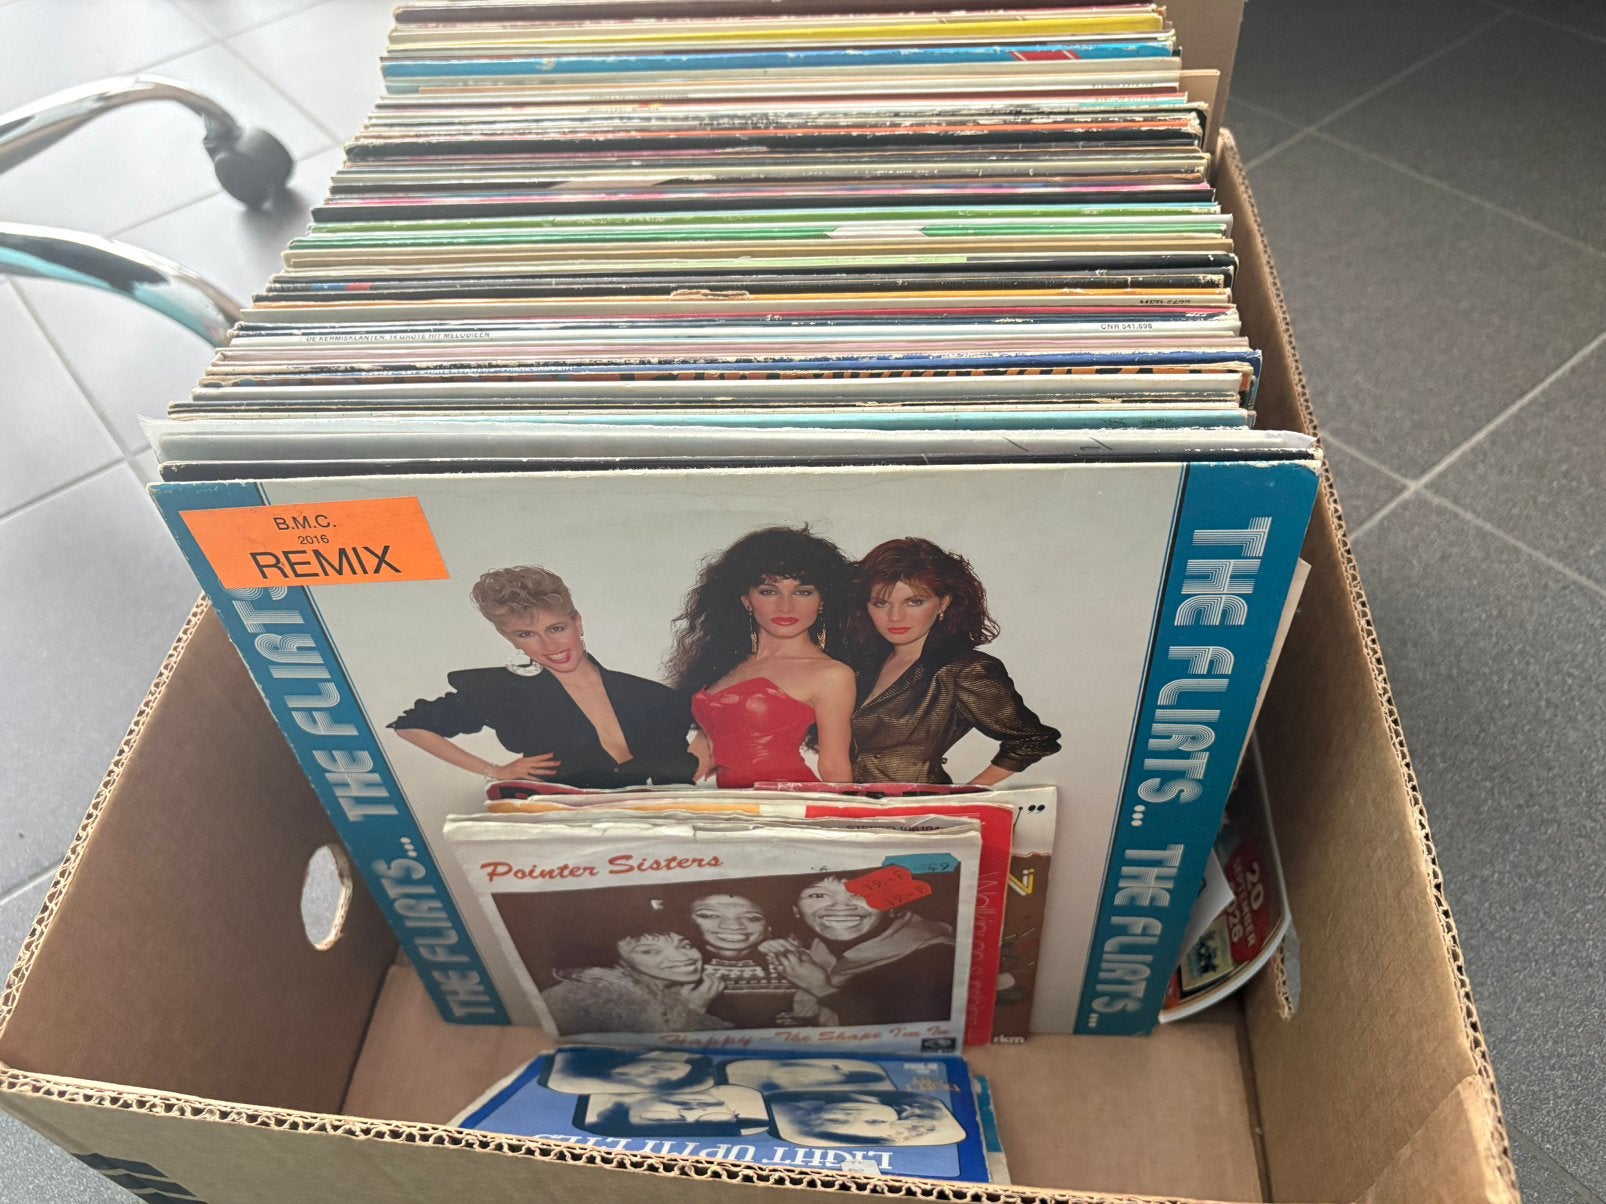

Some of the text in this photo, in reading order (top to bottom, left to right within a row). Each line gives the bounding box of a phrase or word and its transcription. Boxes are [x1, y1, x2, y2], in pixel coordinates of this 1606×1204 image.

[273, 514, 337, 531] B.M.C.
[298, 534, 330, 546] 2016
[249, 545, 402, 579] REMIX
[1130, 516, 1273, 828] THE FLIRTS...
[312, 748, 399, 823] THE
[480, 851, 723, 884] Pointer Sisters
[1245, 861, 1265, 911] 20
[369, 836, 498, 1020] THE FLIRTS...
[1086, 843, 1185, 1029] THE FLIRTS...
[660, 1032, 752, 1049] Happy
[818, 1030, 882, 1043] Shape
[993, 1034, 1025, 1044] rkm
[697, 1143, 758, 1162] UP
